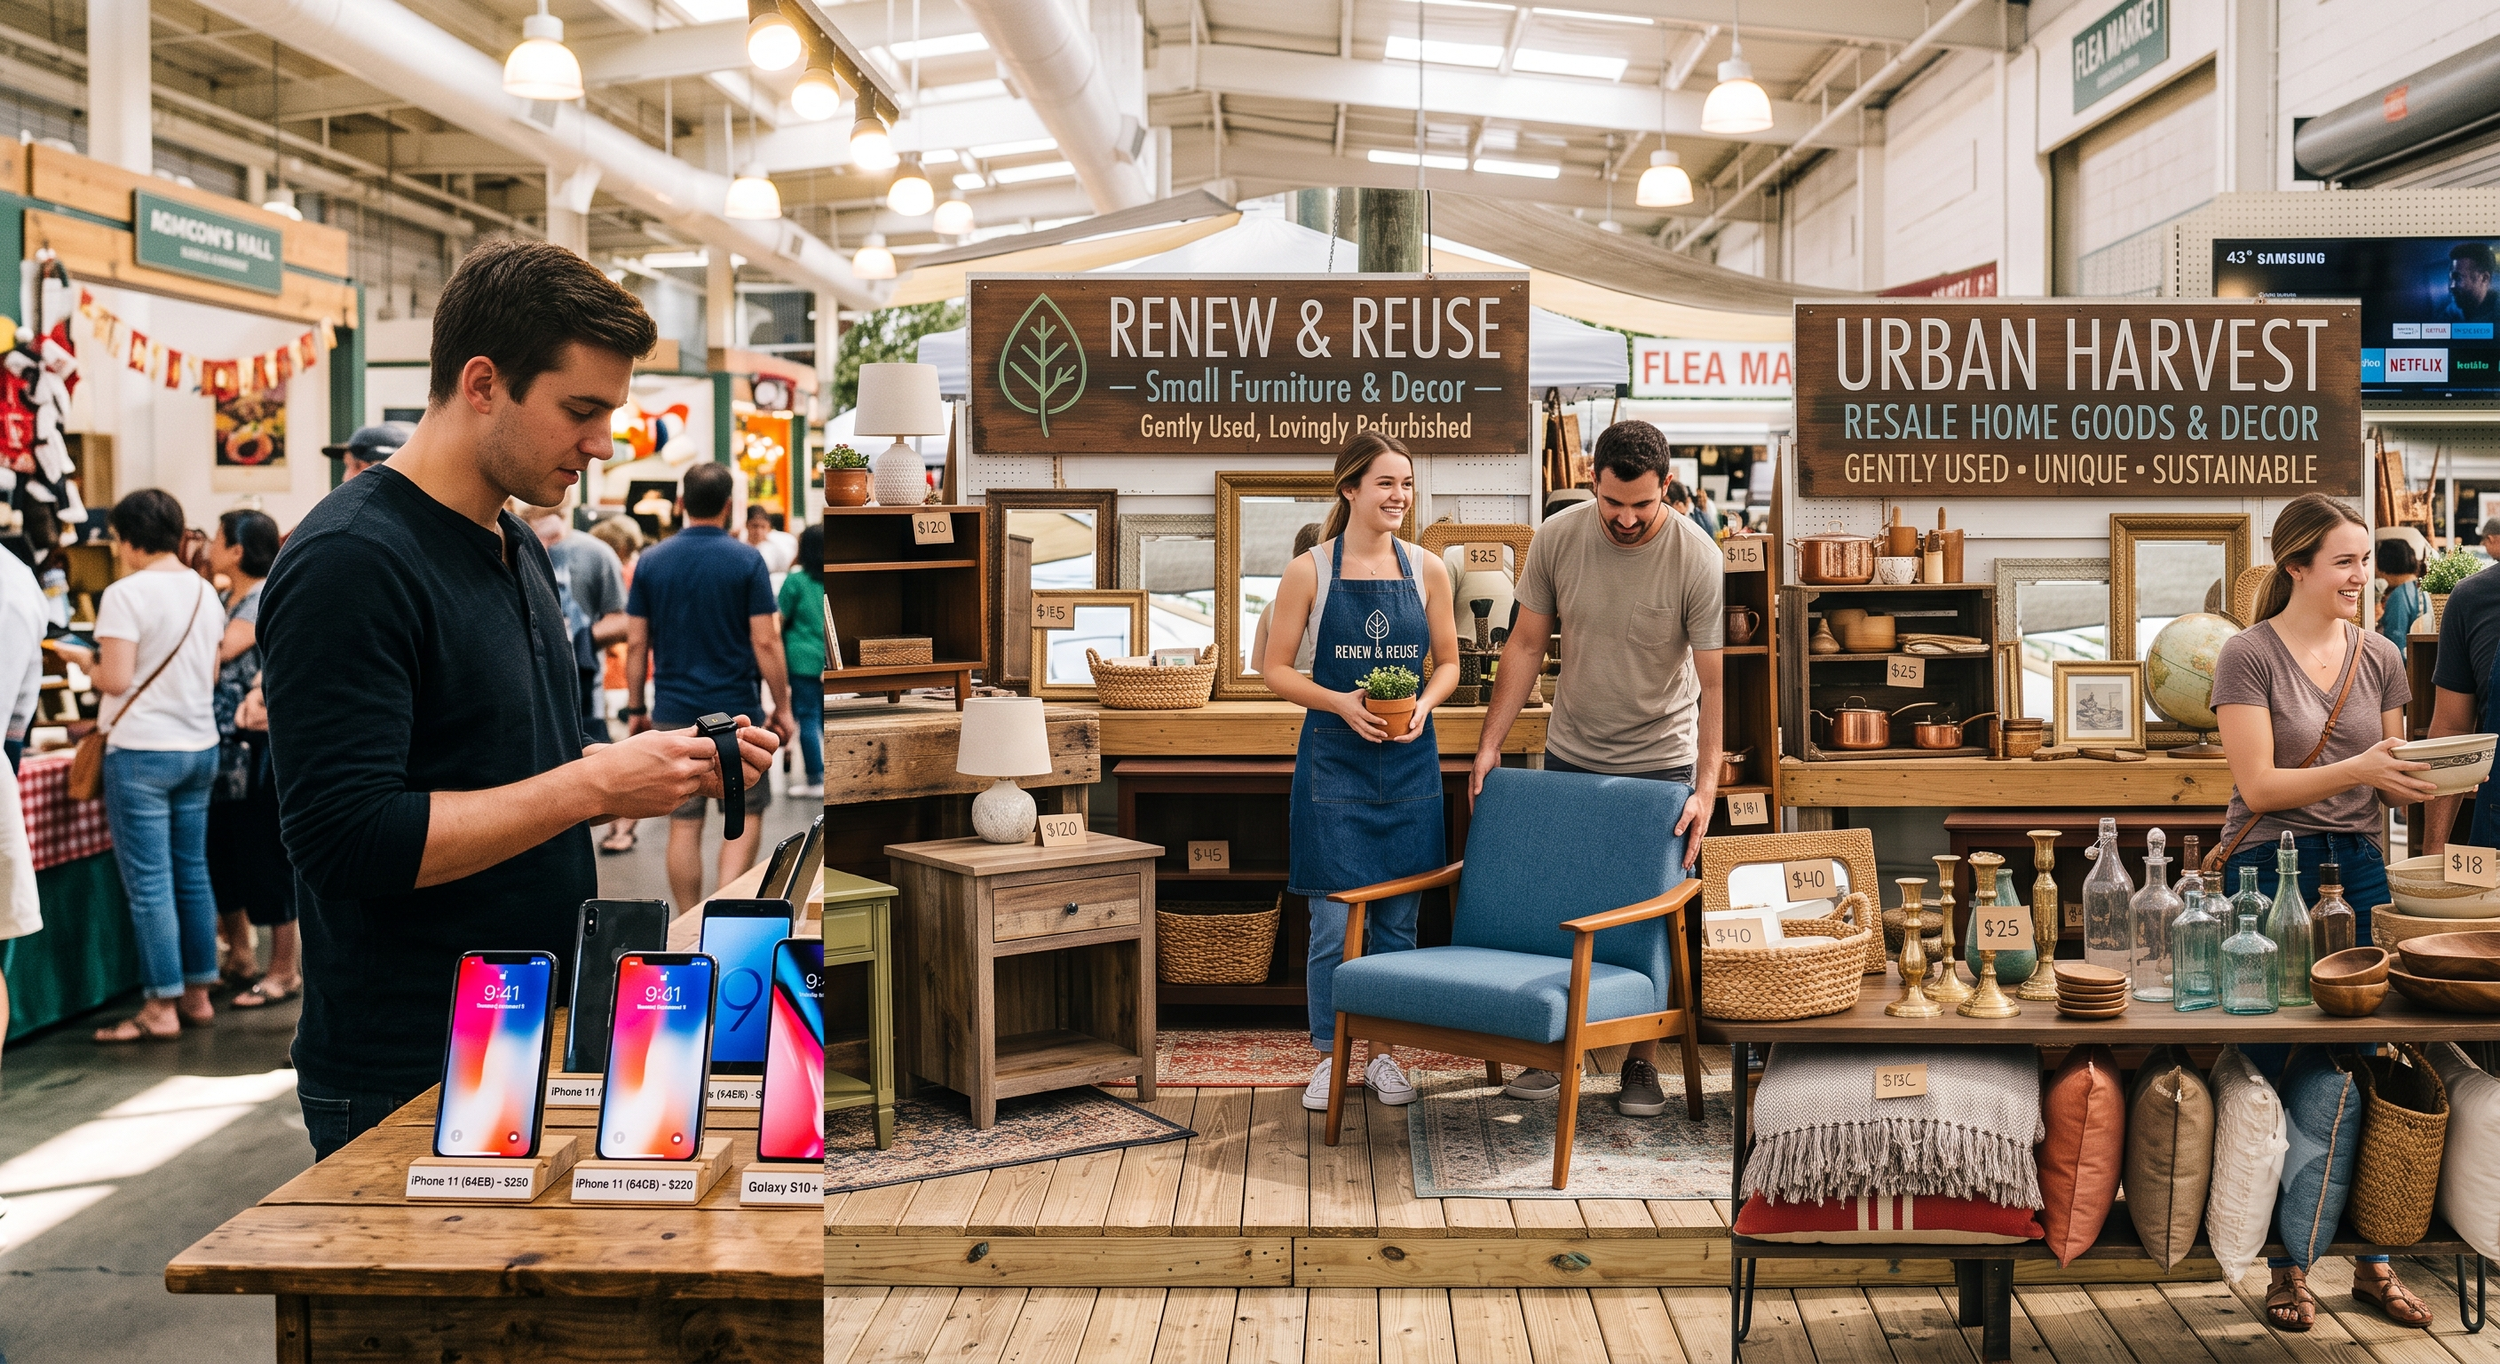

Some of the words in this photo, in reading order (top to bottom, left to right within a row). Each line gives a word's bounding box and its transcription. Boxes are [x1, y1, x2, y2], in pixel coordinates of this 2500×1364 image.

[2075, 29, 2106, 82] FLEA
[236, 231, 276, 262] HALL
[2257, 252, 2326, 265] SAMSUNG
[1110, 296, 1278, 358] RENEW
[1296, 298, 1332, 359] &
[1352, 296, 1501, 359] REUSE
[1836, 317, 2036, 391] URBAN
[2067, 318, 2329, 392] HARVEST
[1643, 351, 1726, 385] FLEA
[2390, 358, 2442, 372] NETFLIX
[1145, 366, 1219, 403] Small
[1230, 370, 1351, 403] Furniture
[1361, 371, 1381, 403] &
[1391, 371, 1466, 403] Decor
[1140, 413, 1203, 445] Gently
[1209, 413, 1261, 443] Used,
[1269, 413, 1349, 445] Lovingly
[1844, 403, 1958, 440] RESALE
[1971, 403, 2058, 440] HOME
[2071, 403, 2175, 441] GOODS
[2187, 404, 2209, 441] &
[2220, 404, 2319, 441] DECOR
[1844, 452, 1937, 483] GENTLY
[1944, 453, 2009, 484] USED
[2034, 453, 2128, 487] UNIQUE
[2152, 453, 2318, 484] SUSTAINABLE
[917, 520, 947, 535] $120
[1335, 644, 1372, 659] RENEW
[1374, 646, 1383, 659] &
[1386, 644, 1419, 659] REUSE
[1891, 663, 1917, 679] $25
[1046, 821, 1077, 838] $120
[1193, 847, 1222, 862] $45
[2452, 853, 2483, 875] $18
[1792, 869, 1825, 889] $40
[1715, 928, 1752, 943] $40
[1984, 918, 2020, 938] $25
[484, 984, 519, 1001] 9:41
[719, 966, 764, 1032] 9
[551, 1087, 582, 1097] iPhone
[584, 1088, 595, 1097] 11
[411, 1175, 445, 1186] iPhone
[448, 1176, 459, 1186] 11
[461, 1177, 495, 1189] (64EB)
[575, 1178, 609, 1190] iPhone
[612, 1179, 623, 1189] 11
[668, 1180, 693, 1190] $220
[748, 1181, 787, 1196] Golaxy
[790, 1182, 818, 1193] S10+
